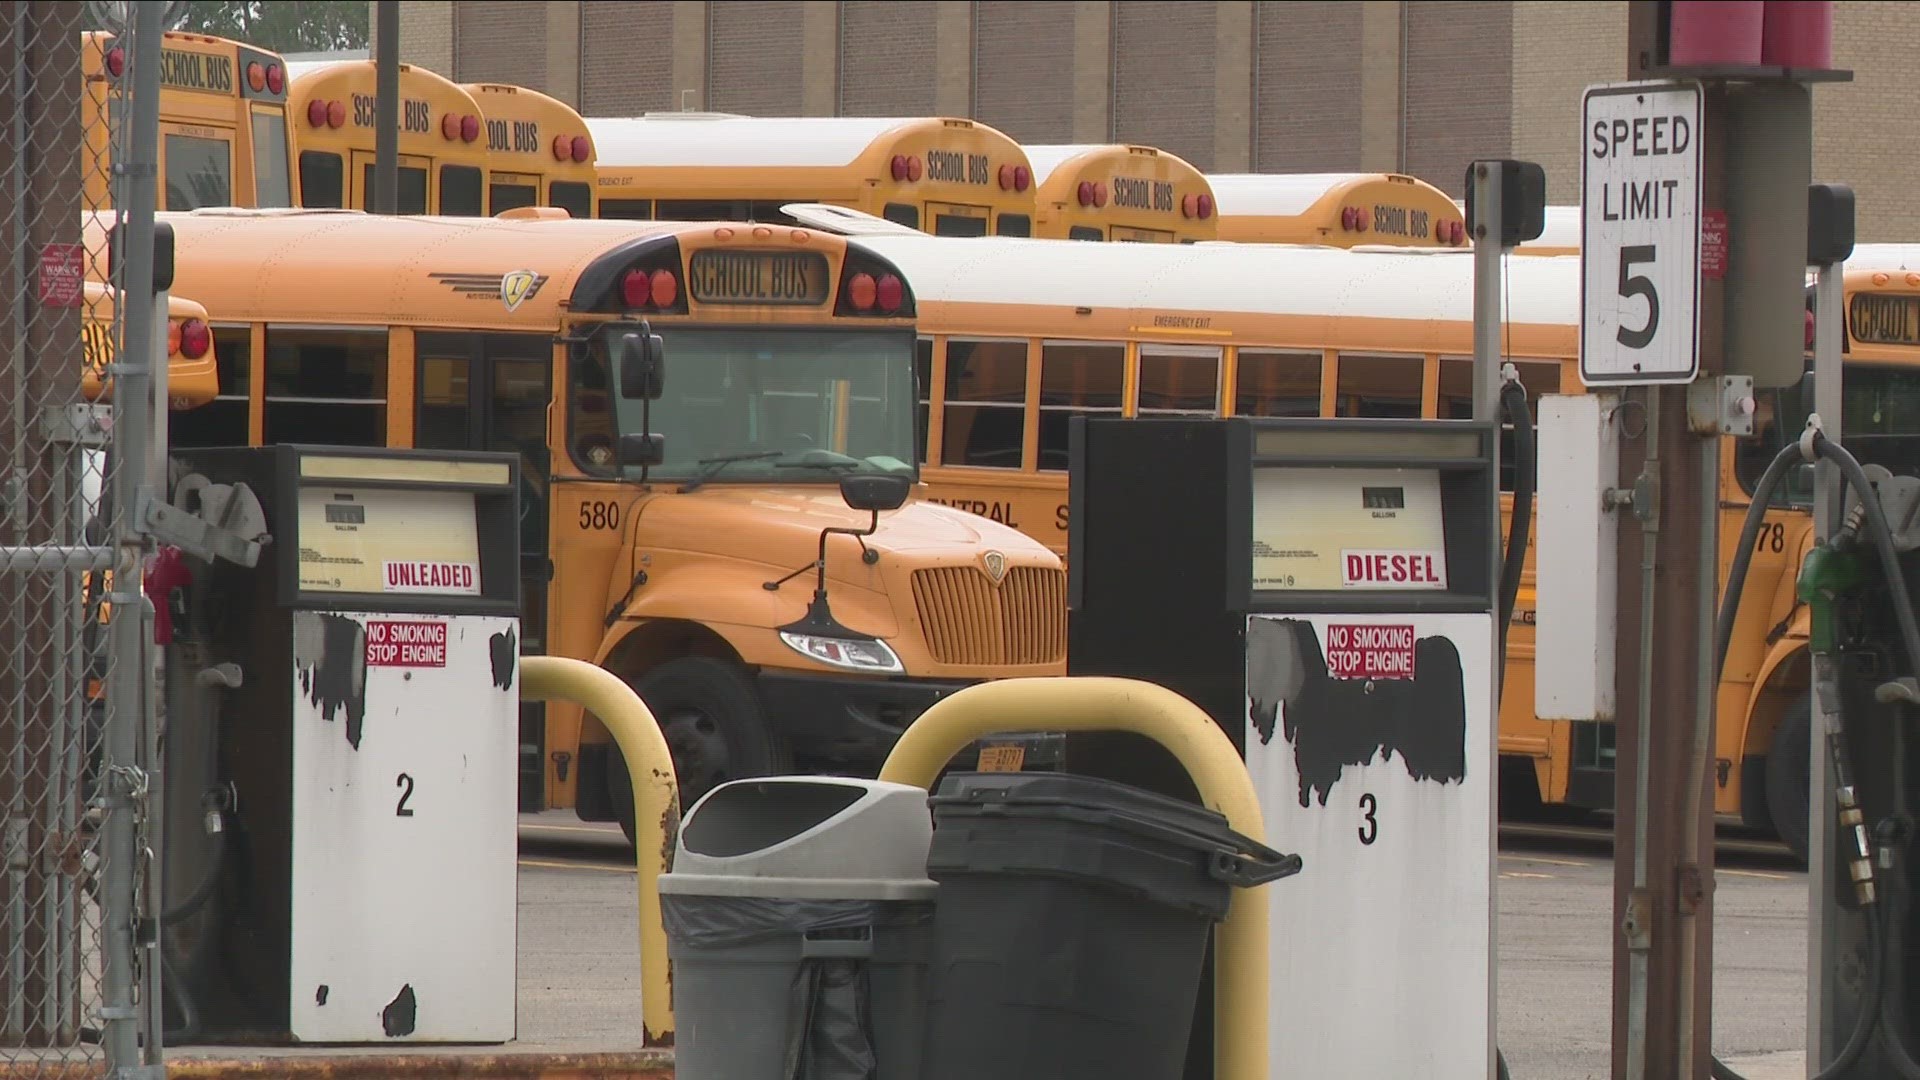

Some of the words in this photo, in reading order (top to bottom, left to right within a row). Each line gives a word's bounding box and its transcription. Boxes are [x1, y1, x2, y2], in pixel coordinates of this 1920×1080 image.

[160, 51, 205, 87] SCHOOL
[206, 56, 230, 91] BUS
[405, 99, 429, 133] BUS
[486, 121, 511, 151] OOL
[514, 122, 538, 152] BUS
[1593, 115, 1690, 160] SPEED
[927, 150, 966, 182] SCHOOL
[968, 154, 989, 185] BUS
[1113, 177, 1151, 209] SCHOOL
[1154, 181, 1173, 212] BUS
[1603, 180, 1678, 222] LIMIT
[1374, 205, 1408, 236] SCHOOL
[1410, 209, 1428, 239] BUS
[692, 255, 766, 298] SCHOOL
[771, 256, 808, 298] BUS
[1616, 244, 1660, 350] 5
[1153, 315, 1195, 328] EMERGENCY
[1195, 317, 1211, 328] EXIT
[1853, 298, 1912, 341] SCHOOL
[579, 501, 619, 530] 580
[387, 562, 472, 588] UNLEADED
[1347, 554, 1439, 582] DIESEL
[368, 624, 386, 643] NO
[390, 624, 444, 643] SMOKING
[1329, 627, 1348, 648] NO
[1353, 627, 1412, 650] SMOKING
[367, 643, 398, 662] STOP
[401, 644, 444, 663] ENGINE
[1328, 650, 1361, 672] STOP
[1365, 651, 1412, 672] ENGINE
[396, 772, 414, 817] 2
[1358, 792, 1377, 846] 3
